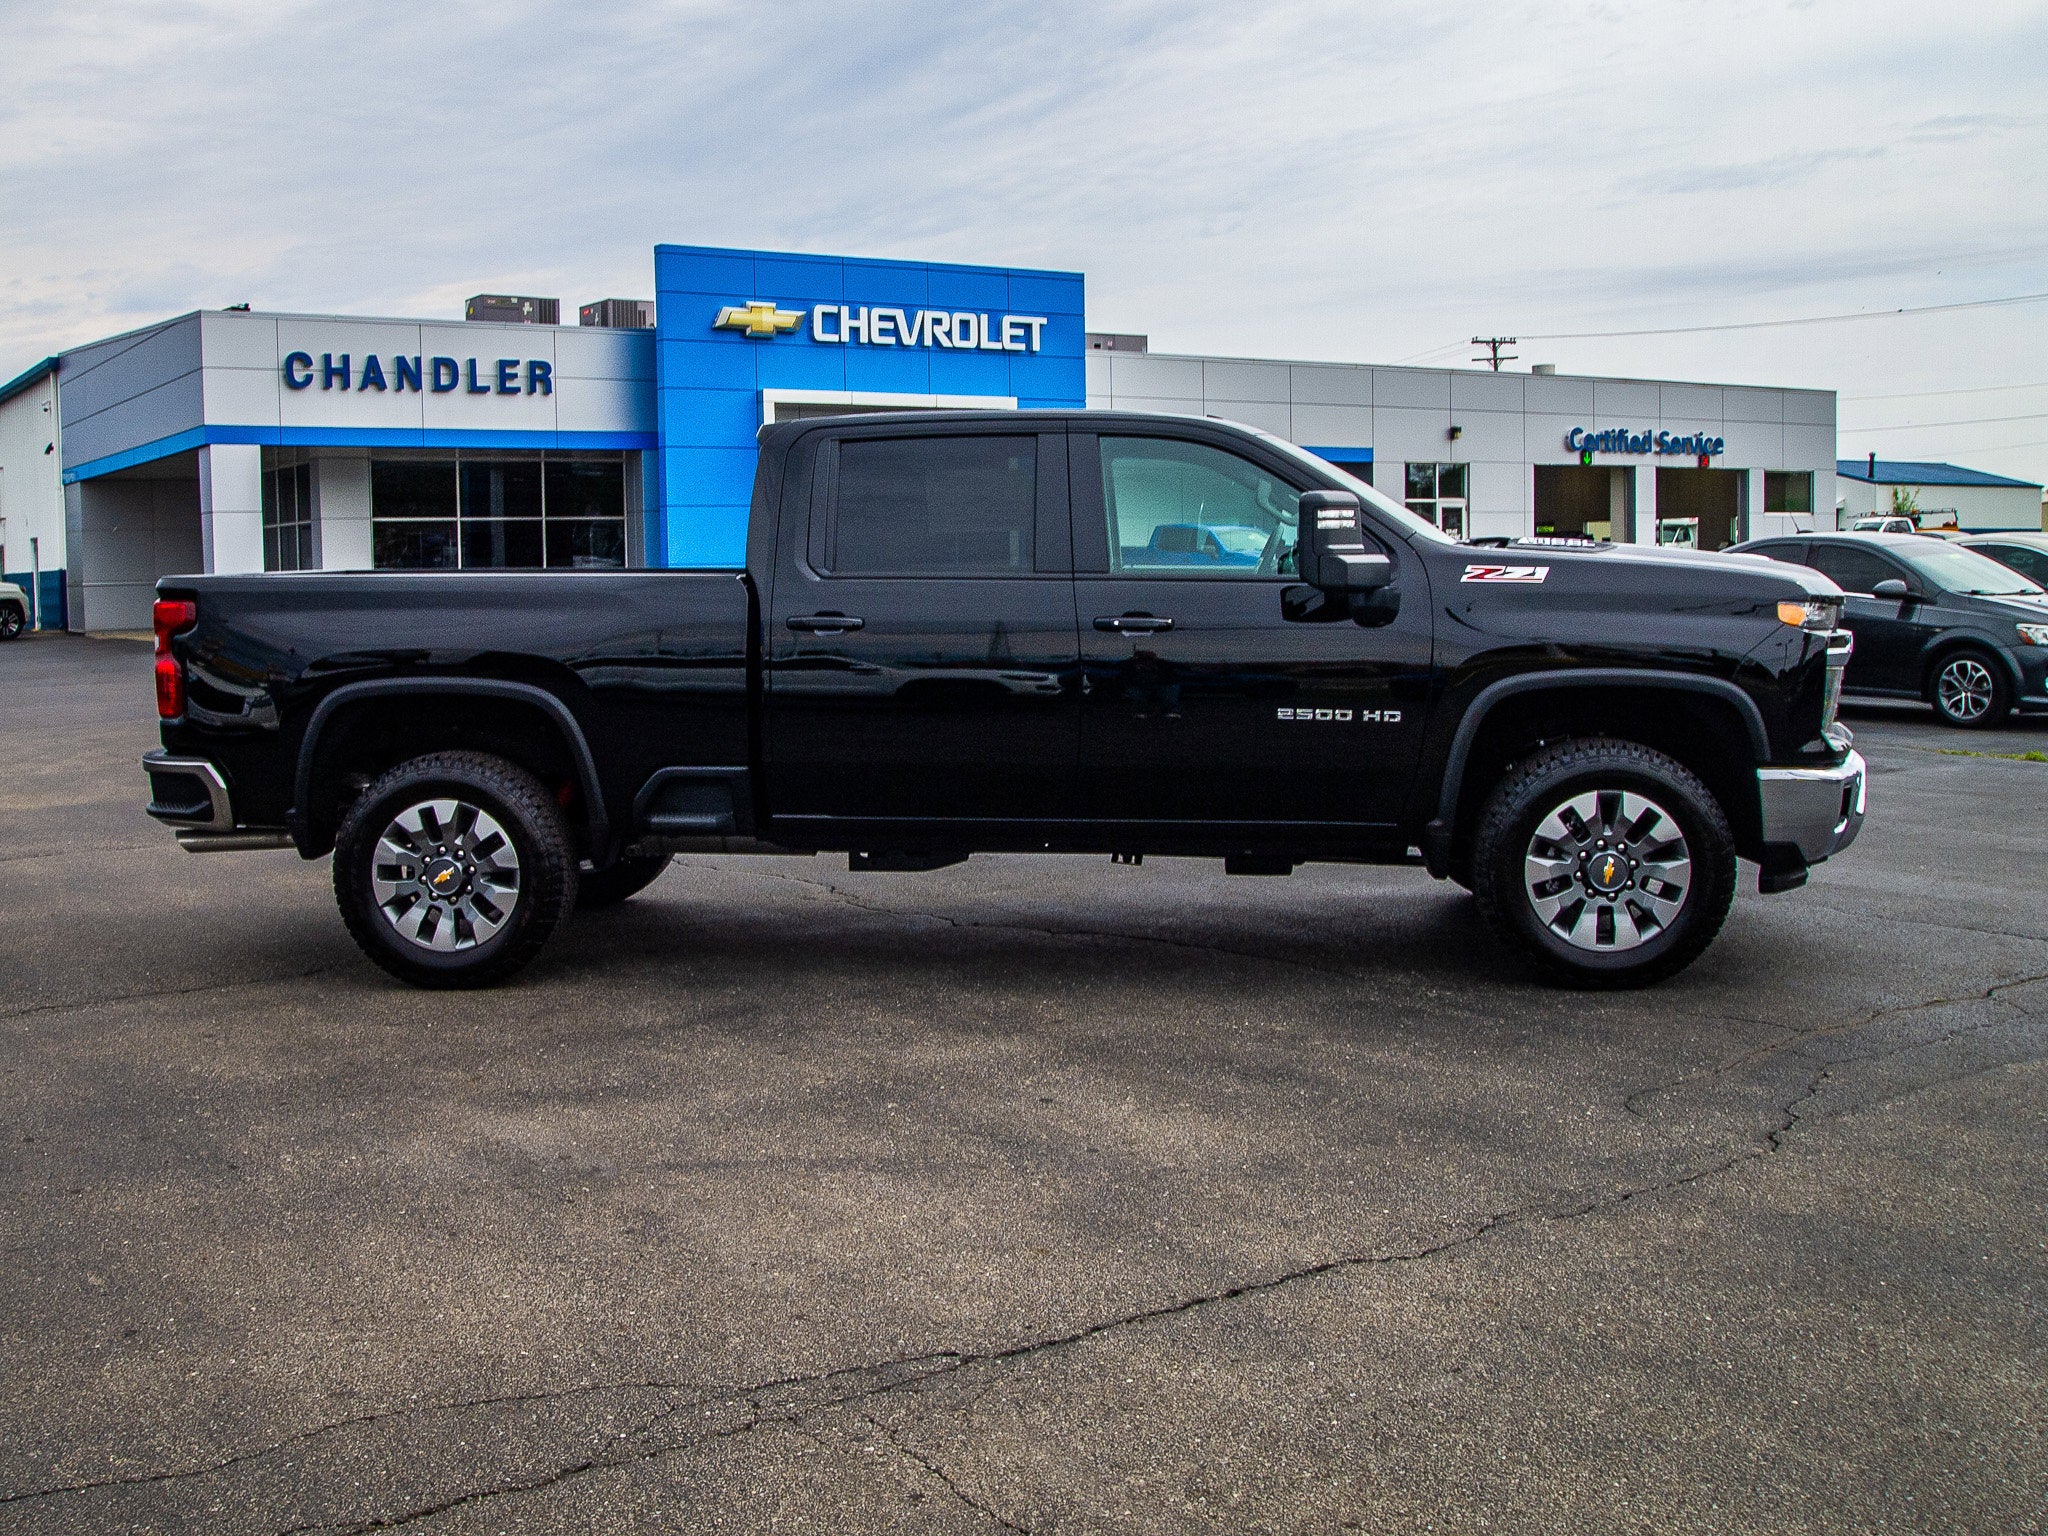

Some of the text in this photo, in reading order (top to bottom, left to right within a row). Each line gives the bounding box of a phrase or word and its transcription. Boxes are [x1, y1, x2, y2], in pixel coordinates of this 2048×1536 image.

[812, 304, 1048, 352] CHEVROLET
[284, 351, 553, 395] CHANDLER
[1569, 426, 1725, 456] Certified Service
[1460, 564, 1550, 584] Z71
[1277, 707, 1401, 723] 2500 HD
